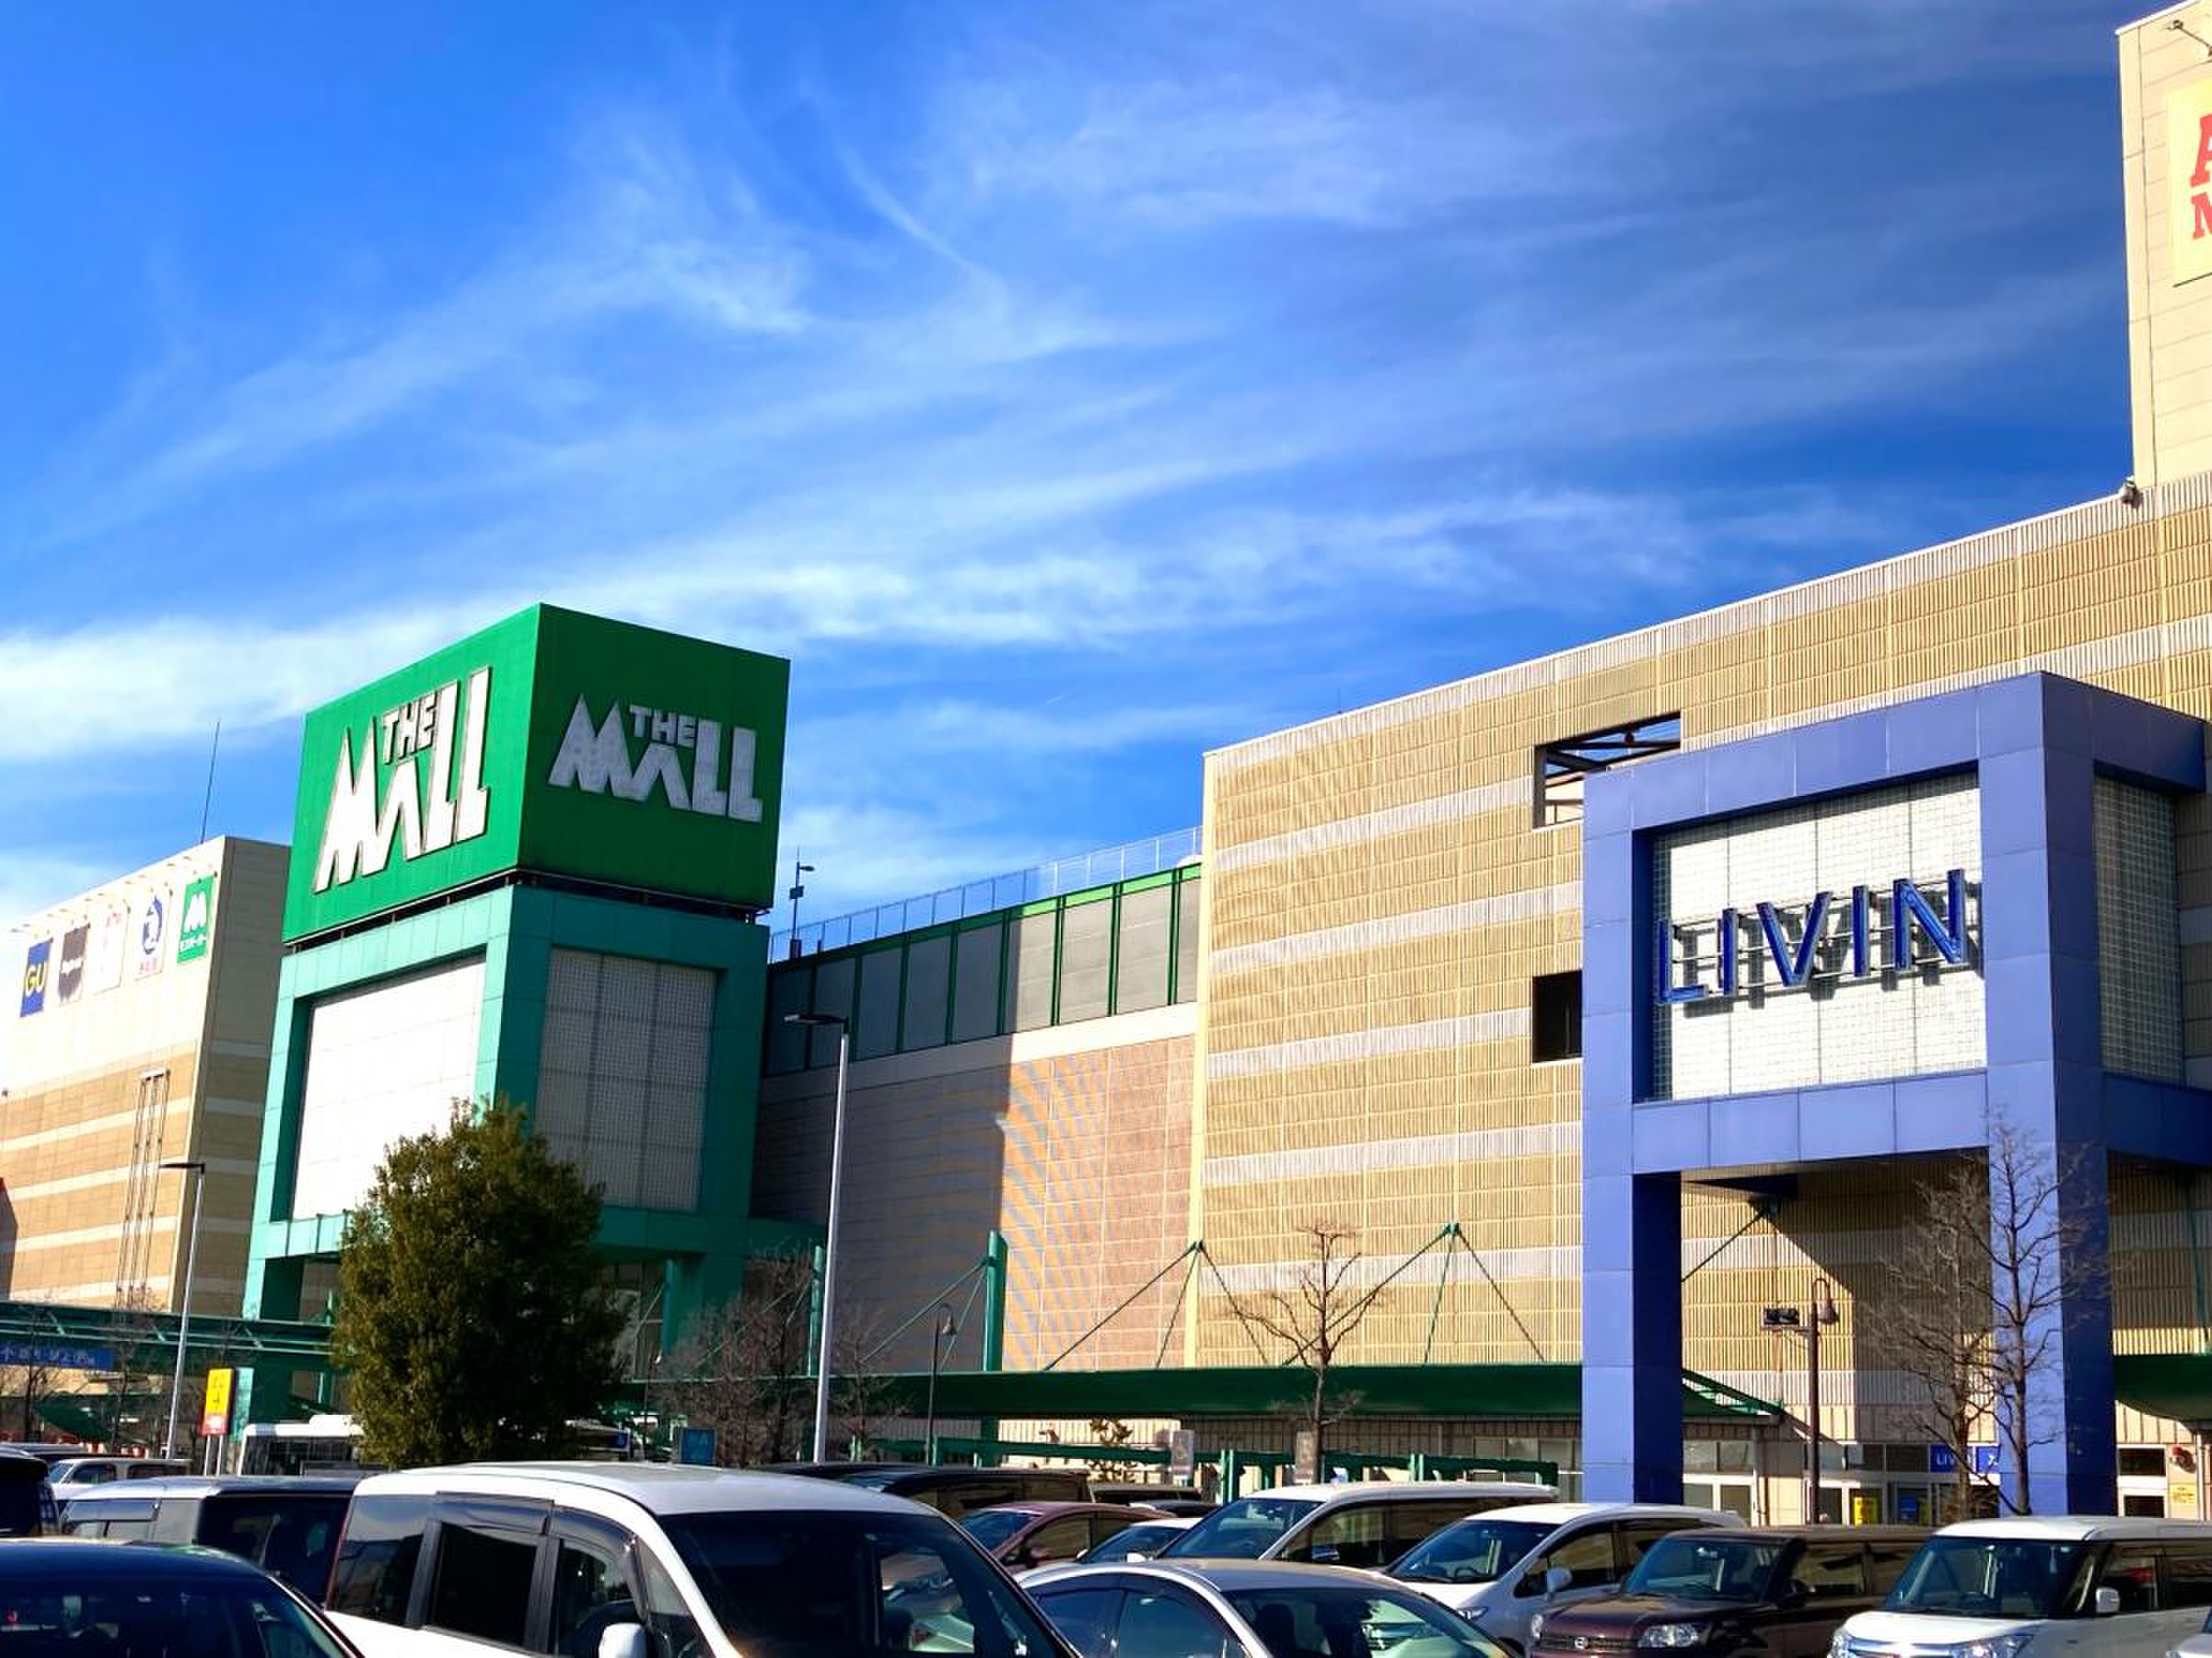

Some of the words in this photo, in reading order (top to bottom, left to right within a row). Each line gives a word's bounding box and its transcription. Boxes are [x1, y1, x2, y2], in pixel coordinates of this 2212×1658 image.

[381, 689, 438, 765] THE
[548, 693, 763, 823] MALL
[629, 705, 698, 748] THE
[312, 665, 491, 893] MALL
[25, 962, 47, 997] GU
[1659, 869, 1969, 1004] LIVIN
